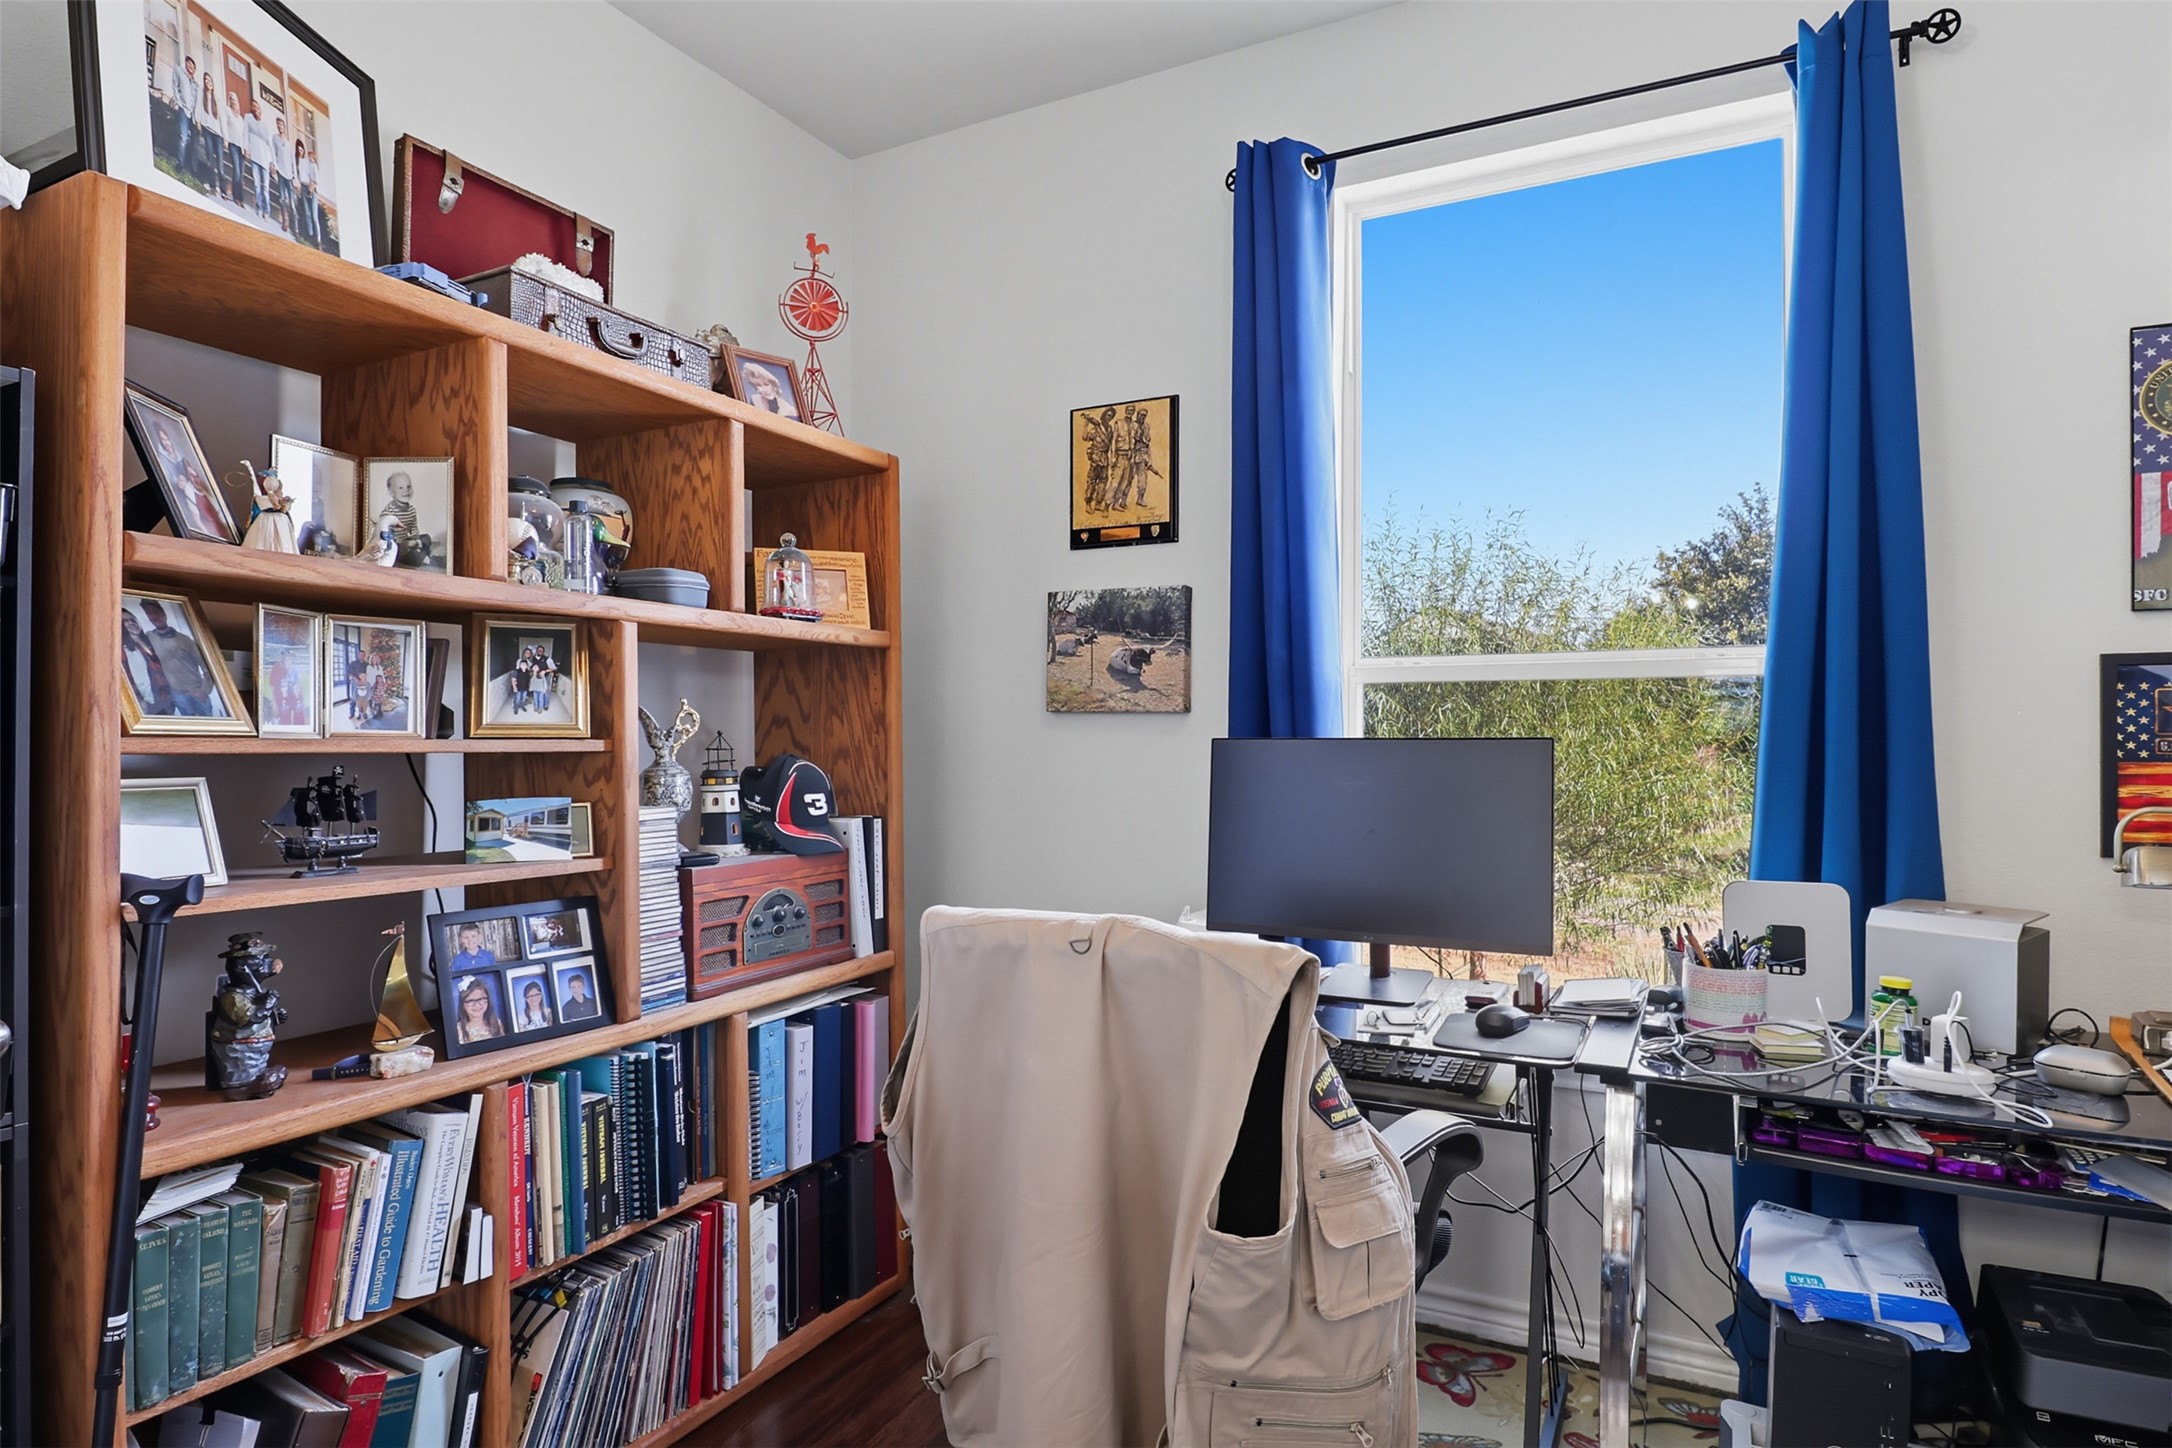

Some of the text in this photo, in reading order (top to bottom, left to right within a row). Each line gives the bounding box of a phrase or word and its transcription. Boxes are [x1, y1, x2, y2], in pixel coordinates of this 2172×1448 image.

[2134, 589, 2168, 602] SFC
[803, 792, 828, 816] 3
[389, 1150, 406, 1201] Illustrated
[384, 1202, 400, 1235] Guide
[381, 1235, 391, 1247] to
[426, 1202, 450, 1273] HEALTH
[368, 1248, 391, 1306] Gardening
[1902, 1280, 1942, 1290] APER
[1919, 1289, 1948, 1300] OPY
